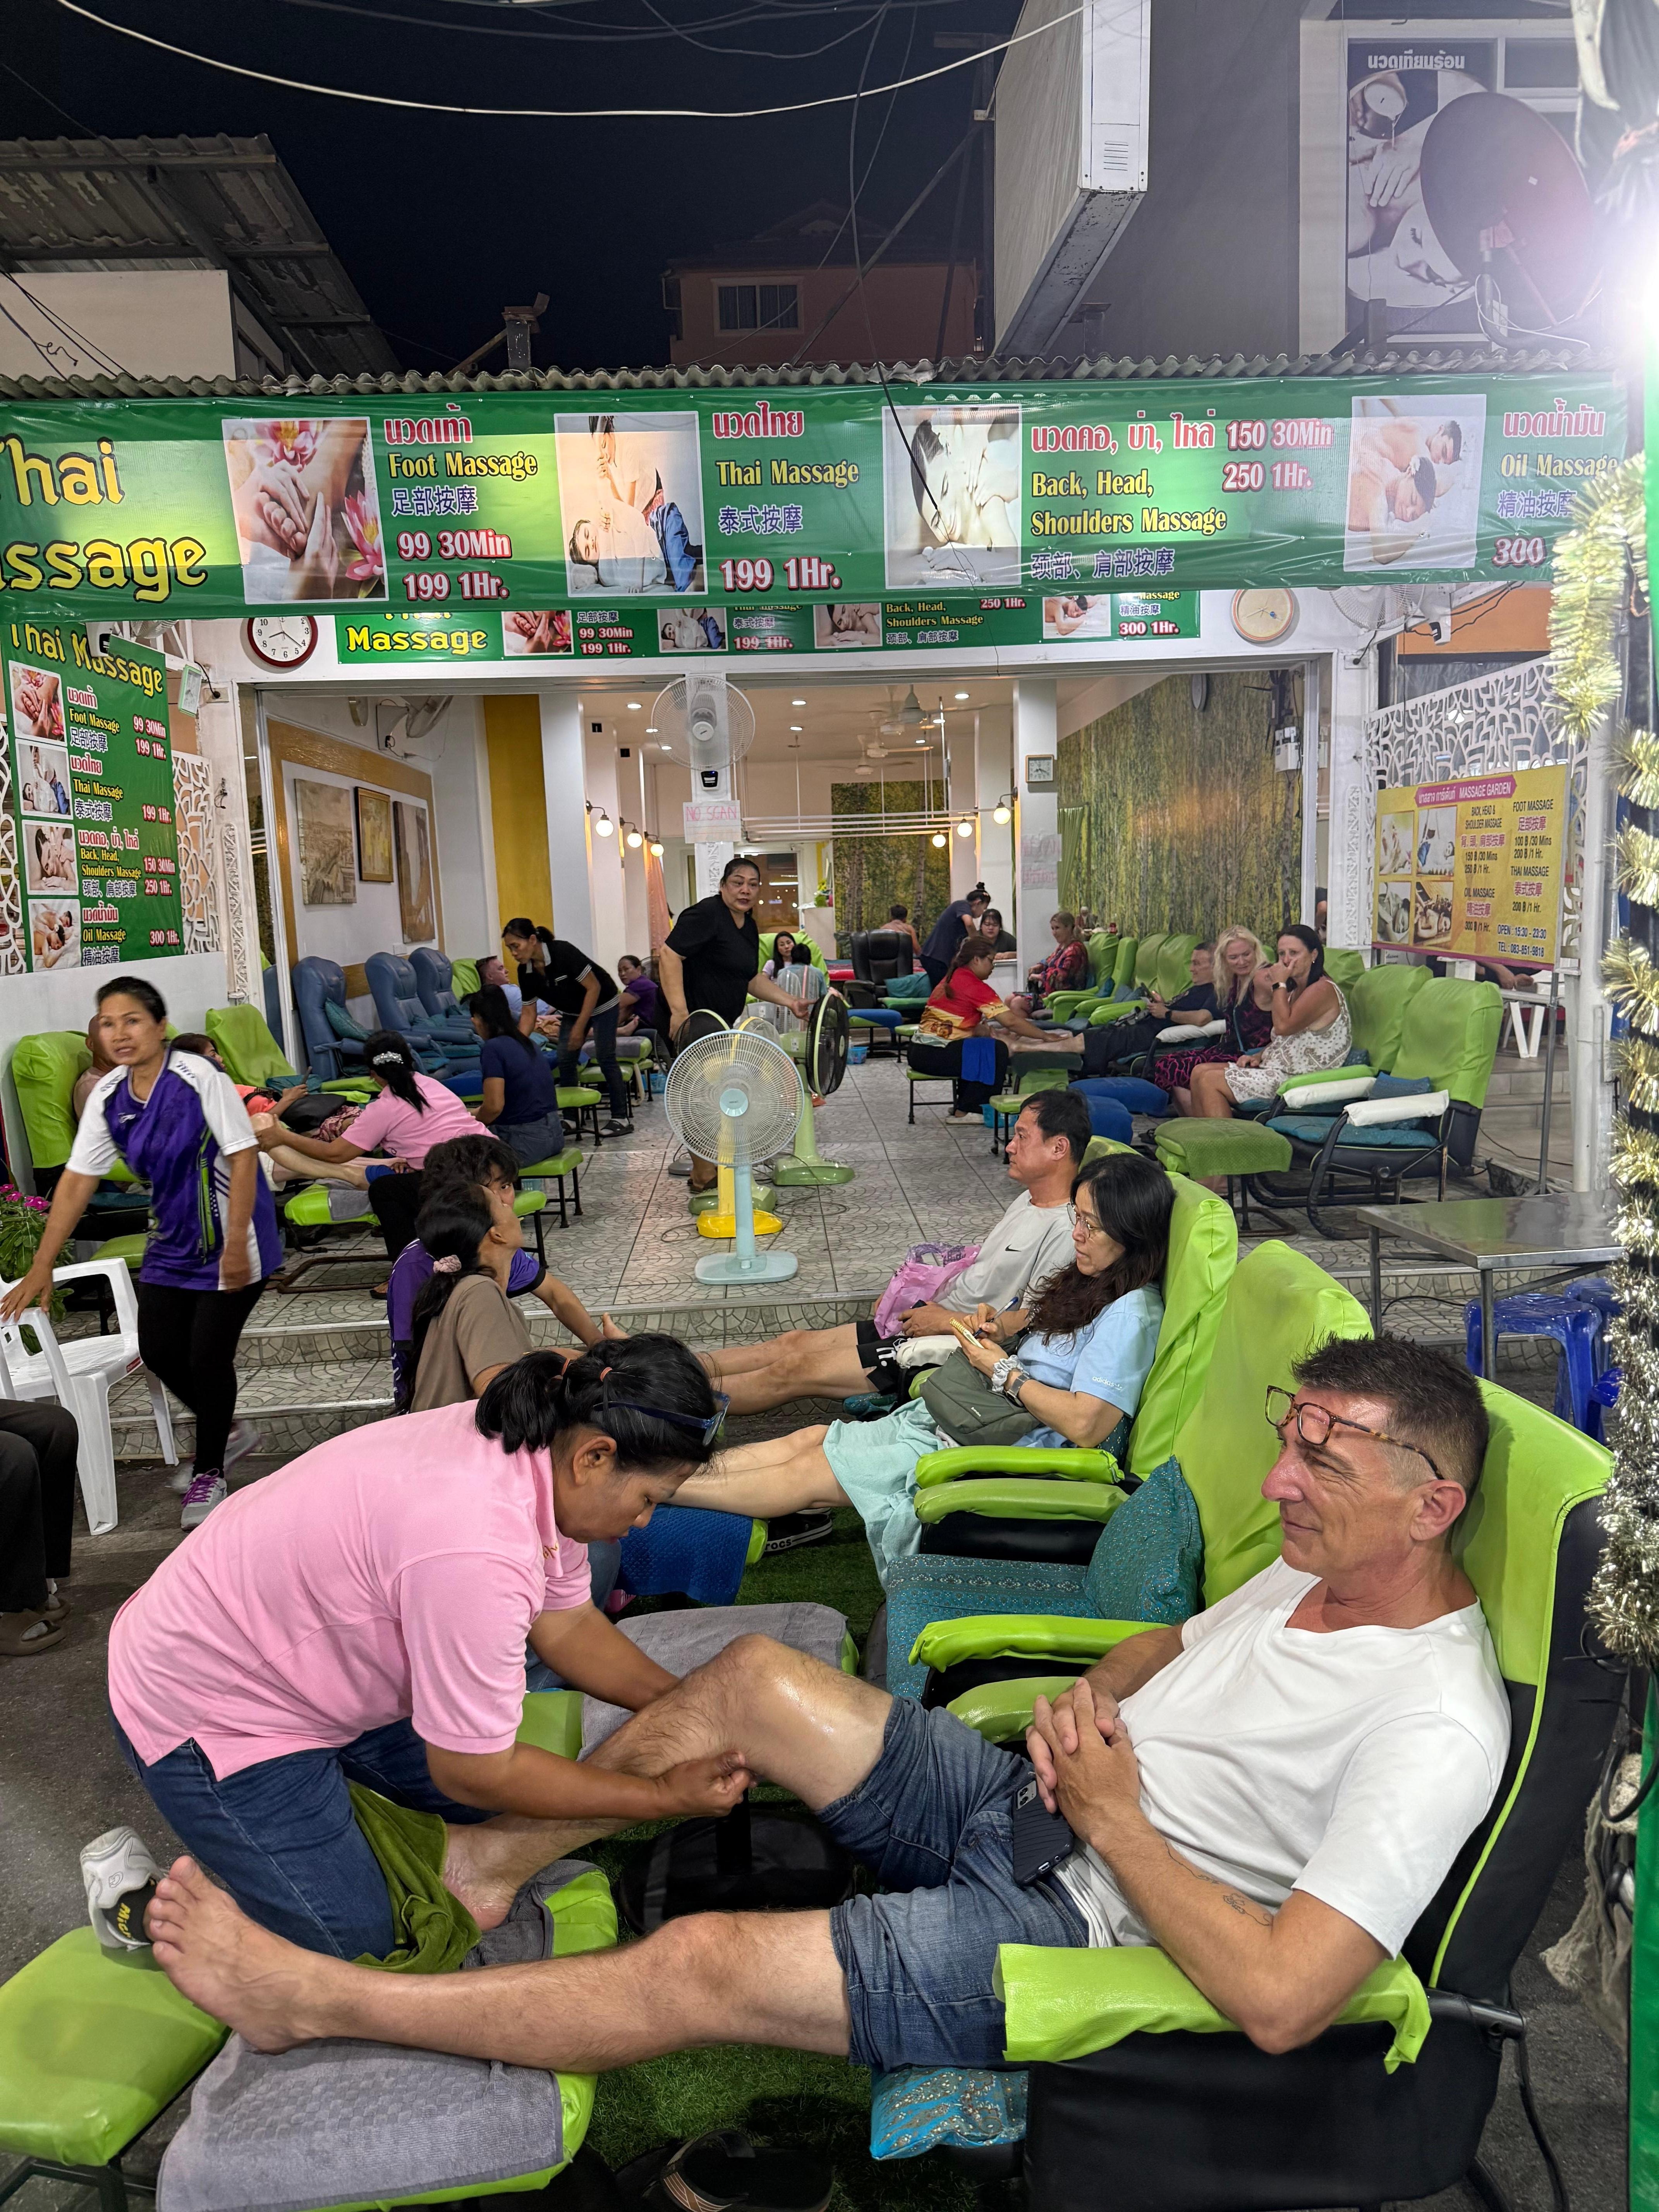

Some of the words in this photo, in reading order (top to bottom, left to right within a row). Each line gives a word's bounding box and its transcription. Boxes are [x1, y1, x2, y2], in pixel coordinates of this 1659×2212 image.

[1368, 49, 1465, 69] นวดเทียนร้อน
[385, 404, 473, 444] นวดเท้า
[713, 401, 805, 439] นวดไทย
[1503, 398, 1606, 438] นวดน้ำมัน
[1031, 422, 1118, 453] นวดคอ,
[1128, 410, 1163, 452] บ่า,
[1172, 409, 1215, 449] ไหล่
[1226, 421, 1267, 451] 150
[1272, 418, 1334, 449] 30Min
[0, 436, 125, 506] hai
[388, 453, 438, 479] Foot
[446, 451, 538, 482] Massage
[716, 462, 762, 487] Thai
[770, 460, 859, 489] Massage
[1222, 462, 1265, 492] 250
[1272, 460, 1314, 490] 1Hr.
[1501, 454, 1528, 477] Oil
[1536, 455, 1618, 478] Massage
[1031, 472, 1088, 500] Back,
[1096, 469, 1154, 498] Head,
[392, 485, 479, 517] 足部按摩
[1498, 489, 1577, 519] 精油按摩
[718, 504, 803, 535] 泰式按摩
[1031, 509, 1134, 536] Shoulders
[1140, 506, 1228, 536] Massage
[398, 531, 431, 561] 99
[438, 529, 512, 559] 30Min
[1492, 537, 1546, 568] 300
[0, 538, 207, 603] ssage
[719, 558, 774, 592] 199
[783, 556, 842, 590] 1Hr.
[1030, 548, 1175, 580] 颈部、肩部按摩
[403, 572, 450, 601] 199
[458, 570, 510, 599] 1Hr.
[886, 603, 913, 614] Back,
[917, 601, 946, 612] Head,
[980, 598, 1001, 610] 250
[1003, 598, 1027, 609] 1Hr.
[1119, 603, 1161, 617] 精油按摩
[577, 611, 619, 623] 足部按摩
[733, 617, 775, 629] 泰式按摩
[886, 617, 937, 628] Shoulders
[941, 614, 984, 627] Massage
[579, 627, 596, 639] 99
[598, 627, 634, 639] 30Min
[1119, 621, 1147, 635] 300
[1151, 620, 1180, 635] 1Hr.
[346, 626, 488, 655] Massage
[580, 643, 604, 655] 199
[607, 642, 632, 654] 1Hr.
[733, 637, 760, 650] 199
[67, 685, 98, 710] นวดเท้า
[69, 708, 88, 726] Foot
[89, 714, 120, 735] Massage
[133, 715, 144, 733] 99
[145, 718, 166, 739] 30Min
[70, 727, 108, 753] 足部按摩
[135, 737, 150, 756] 199
[152, 742, 167, 761] 1Hr.
[70, 752, 103, 776] นวดไทย
[73, 778, 91, 794] Thai
[93, 781, 123, 801] Massage
[1459, 785, 1486, 799] MASSAGE
[1487, 781, 1511, 797] GARDEN
[74, 799, 113, 822] 泰式按摩
[142, 804, 156, 821] 199
[158, 807, 172, 824] 1Hr.
[685, 806, 701, 822] NO
[706, 805, 737, 821] SCAN
[1482, 805, 1491, 815] HEAD
[1513, 801, 1527, 812] FOOT
[1527, 799, 1554, 811] MASSAGE
[1465, 819, 1485, 830] SHOULDER
[1485, 818, 1502, 828] MASSAGE
[1518, 816, 1547, 831] 足部按摩
[1515, 836, 1523, 847] 100
[1529, 836, 1538, 847] /30
[1539, 835, 1552, 846] Mins
[81, 849, 100, 862] Back,
[101, 851, 120, 863] Head,
[1486, 851, 1498, 861] Mins
[1514, 848, 1523, 859] 200
[81, 864, 114, 877] Shoulders
[117, 866, 142, 879] Massage
[143, 856, 156, 874] 150
[157, 858, 175, 875] 30Min
[1465, 864, 1473, 874] 250
[1511, 866, 1522, 876] THAI
[1523, 866, 1549, 876] MASSAGE
[144, 878, 158, 895] 250
[159, 879, 173, 896] 1Hr.
[1473, 888, 1495, 898] MASSAGE
[82, 900, 119, 924] นวดน้ำมัน
[1512, 901, 1522, 911] 200
[82, 929, 94, 942] Oil
[96, 929, 126, 943] Massage
[149, 930, 165, 946] 300
[166, 930, 180, 945] 1Hr.
[1498, 924, 1511, 935] OPEN
[82, 945, 120, 966] 精油按摩
[1498, 941, 1507, 952] TEL
[1092, 1376, 1115, 1387] adidas
[765, 1539, 792, 1550] rocs
